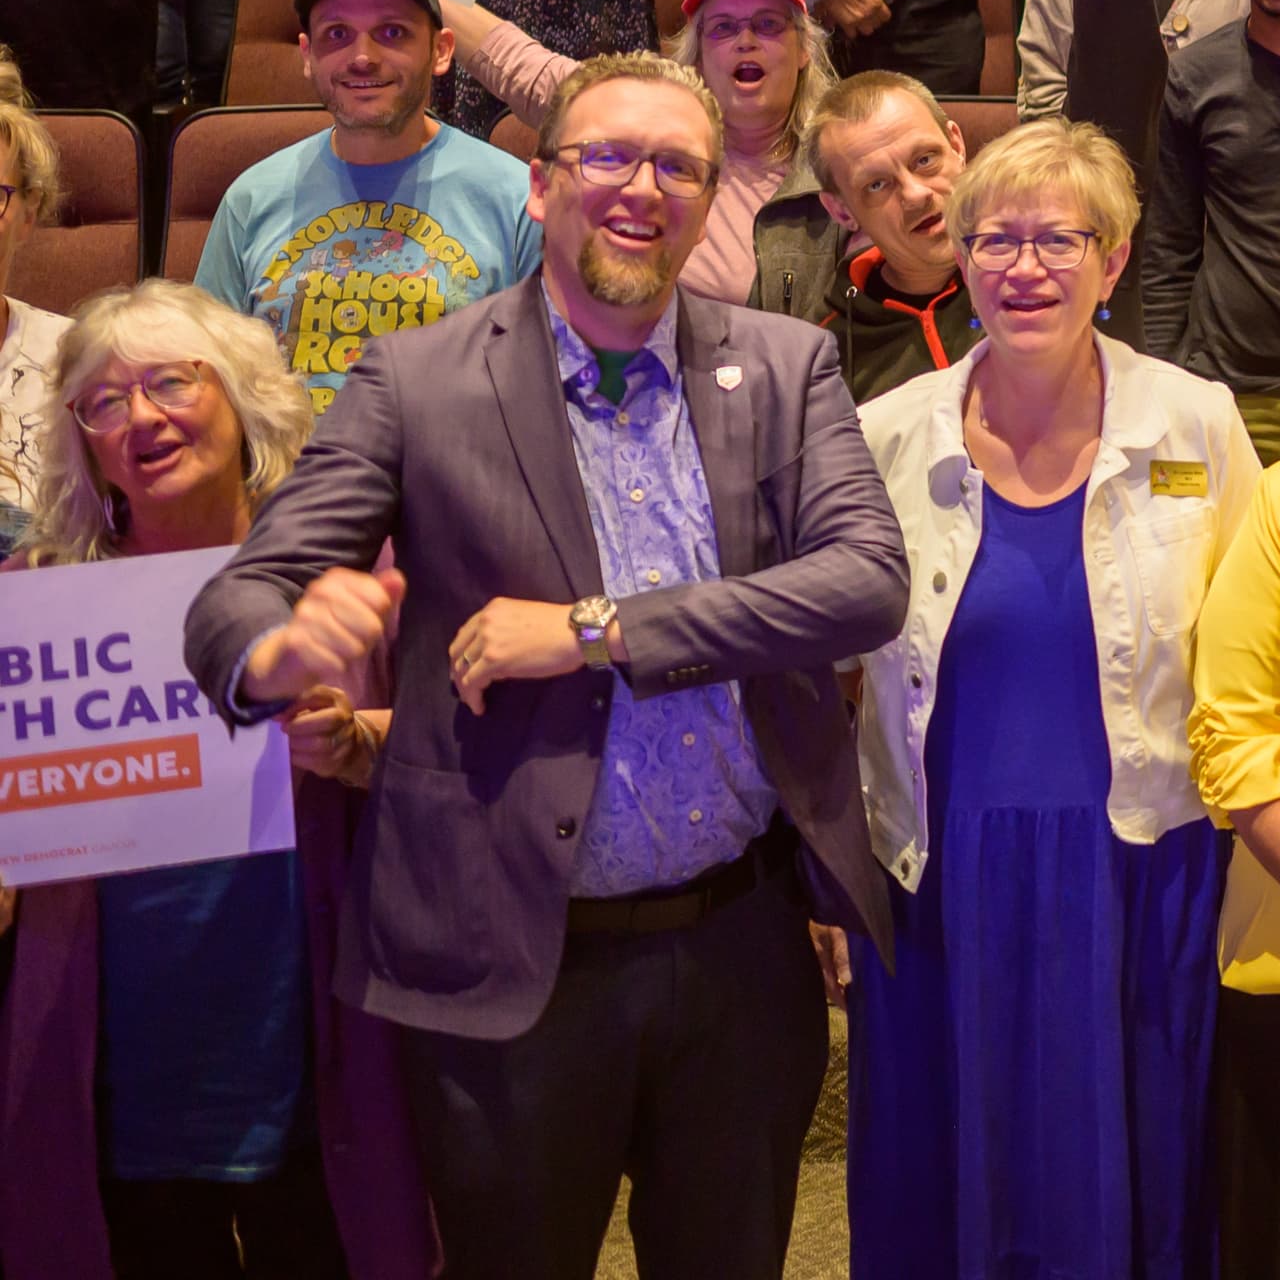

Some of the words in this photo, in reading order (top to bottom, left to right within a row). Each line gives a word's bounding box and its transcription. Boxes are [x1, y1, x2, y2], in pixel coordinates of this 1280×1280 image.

[260, 200, 481, 284] KNOWLEDGE
[304, 270, 445, 305] SCHOOL
[299, 298, 446, 337] HOUSE
[0, 631, 134, 688] BLIC
[74, 679, 216, 731] CAR
[0, 750, 191, 801] VERYONE.
[24, 845, 90, 863] DEMOCRAT
